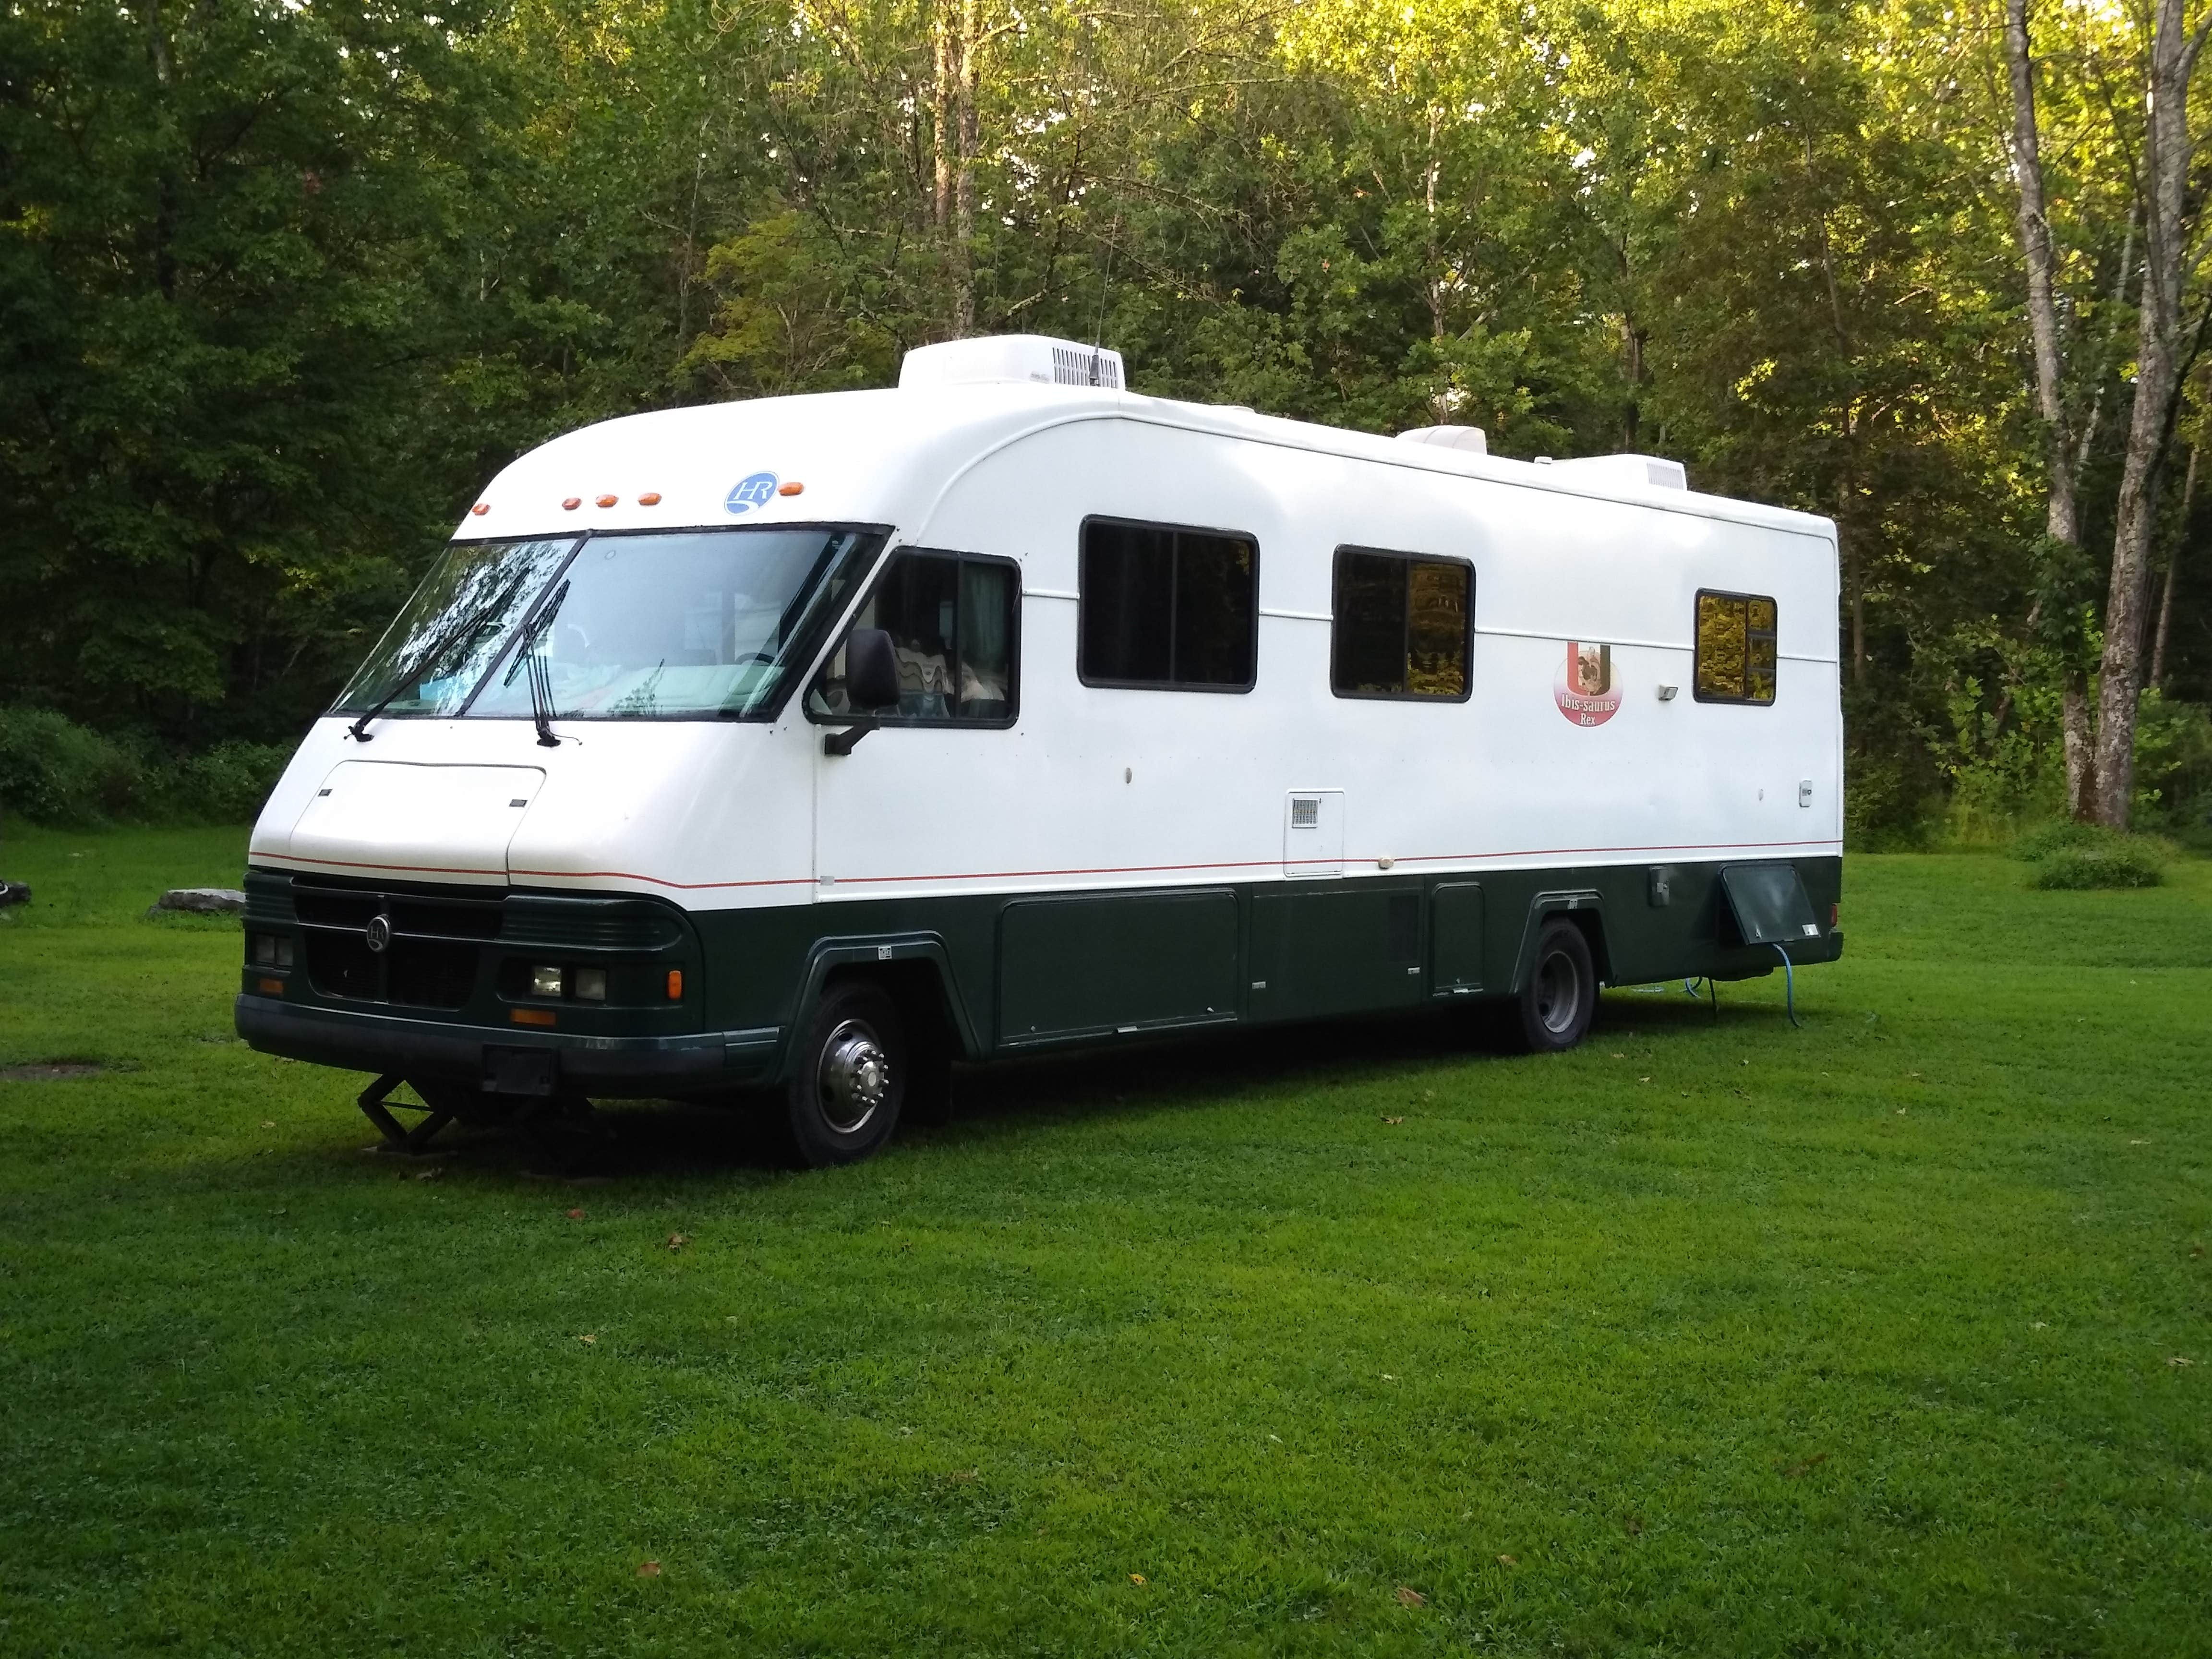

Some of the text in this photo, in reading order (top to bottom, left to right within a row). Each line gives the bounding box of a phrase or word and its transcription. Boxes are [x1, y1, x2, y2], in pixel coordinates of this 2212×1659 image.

[733, 481, 773, 500] HR
[1561, 694, 1615, 712] Ibis-saurus
[1580, 713, 1596, 725] Rex
[371, 926, 385, 939] HR
